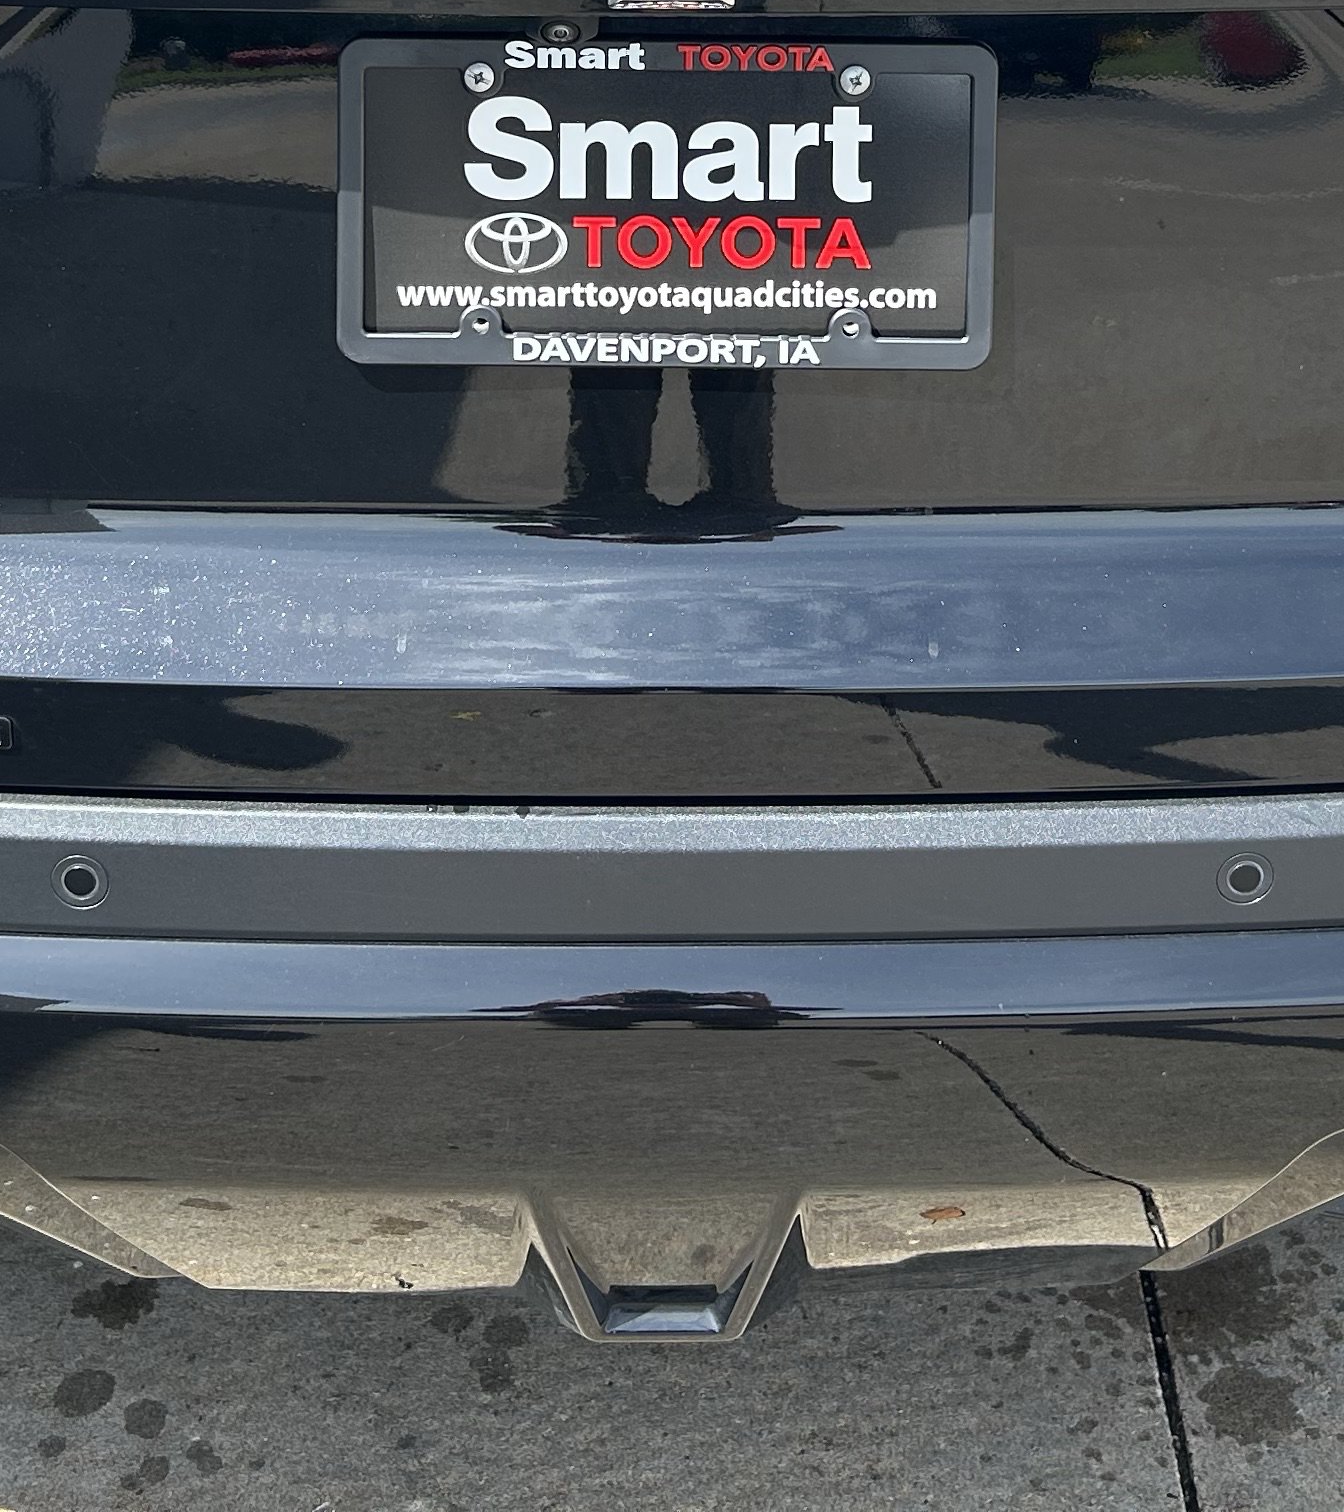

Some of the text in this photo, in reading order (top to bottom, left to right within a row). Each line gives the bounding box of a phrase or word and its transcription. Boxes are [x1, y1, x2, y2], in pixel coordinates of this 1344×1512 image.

[505, 41, 834, 72] Smart TOYOTA
[464, 96, 873, 202] Smart
[573, 215, 871, 270] TOYOTA
[397, 280, 937, 315] www.smarttoyotaquadcities.com
[513, 337, 821, 368] DAVENPORT, IA
